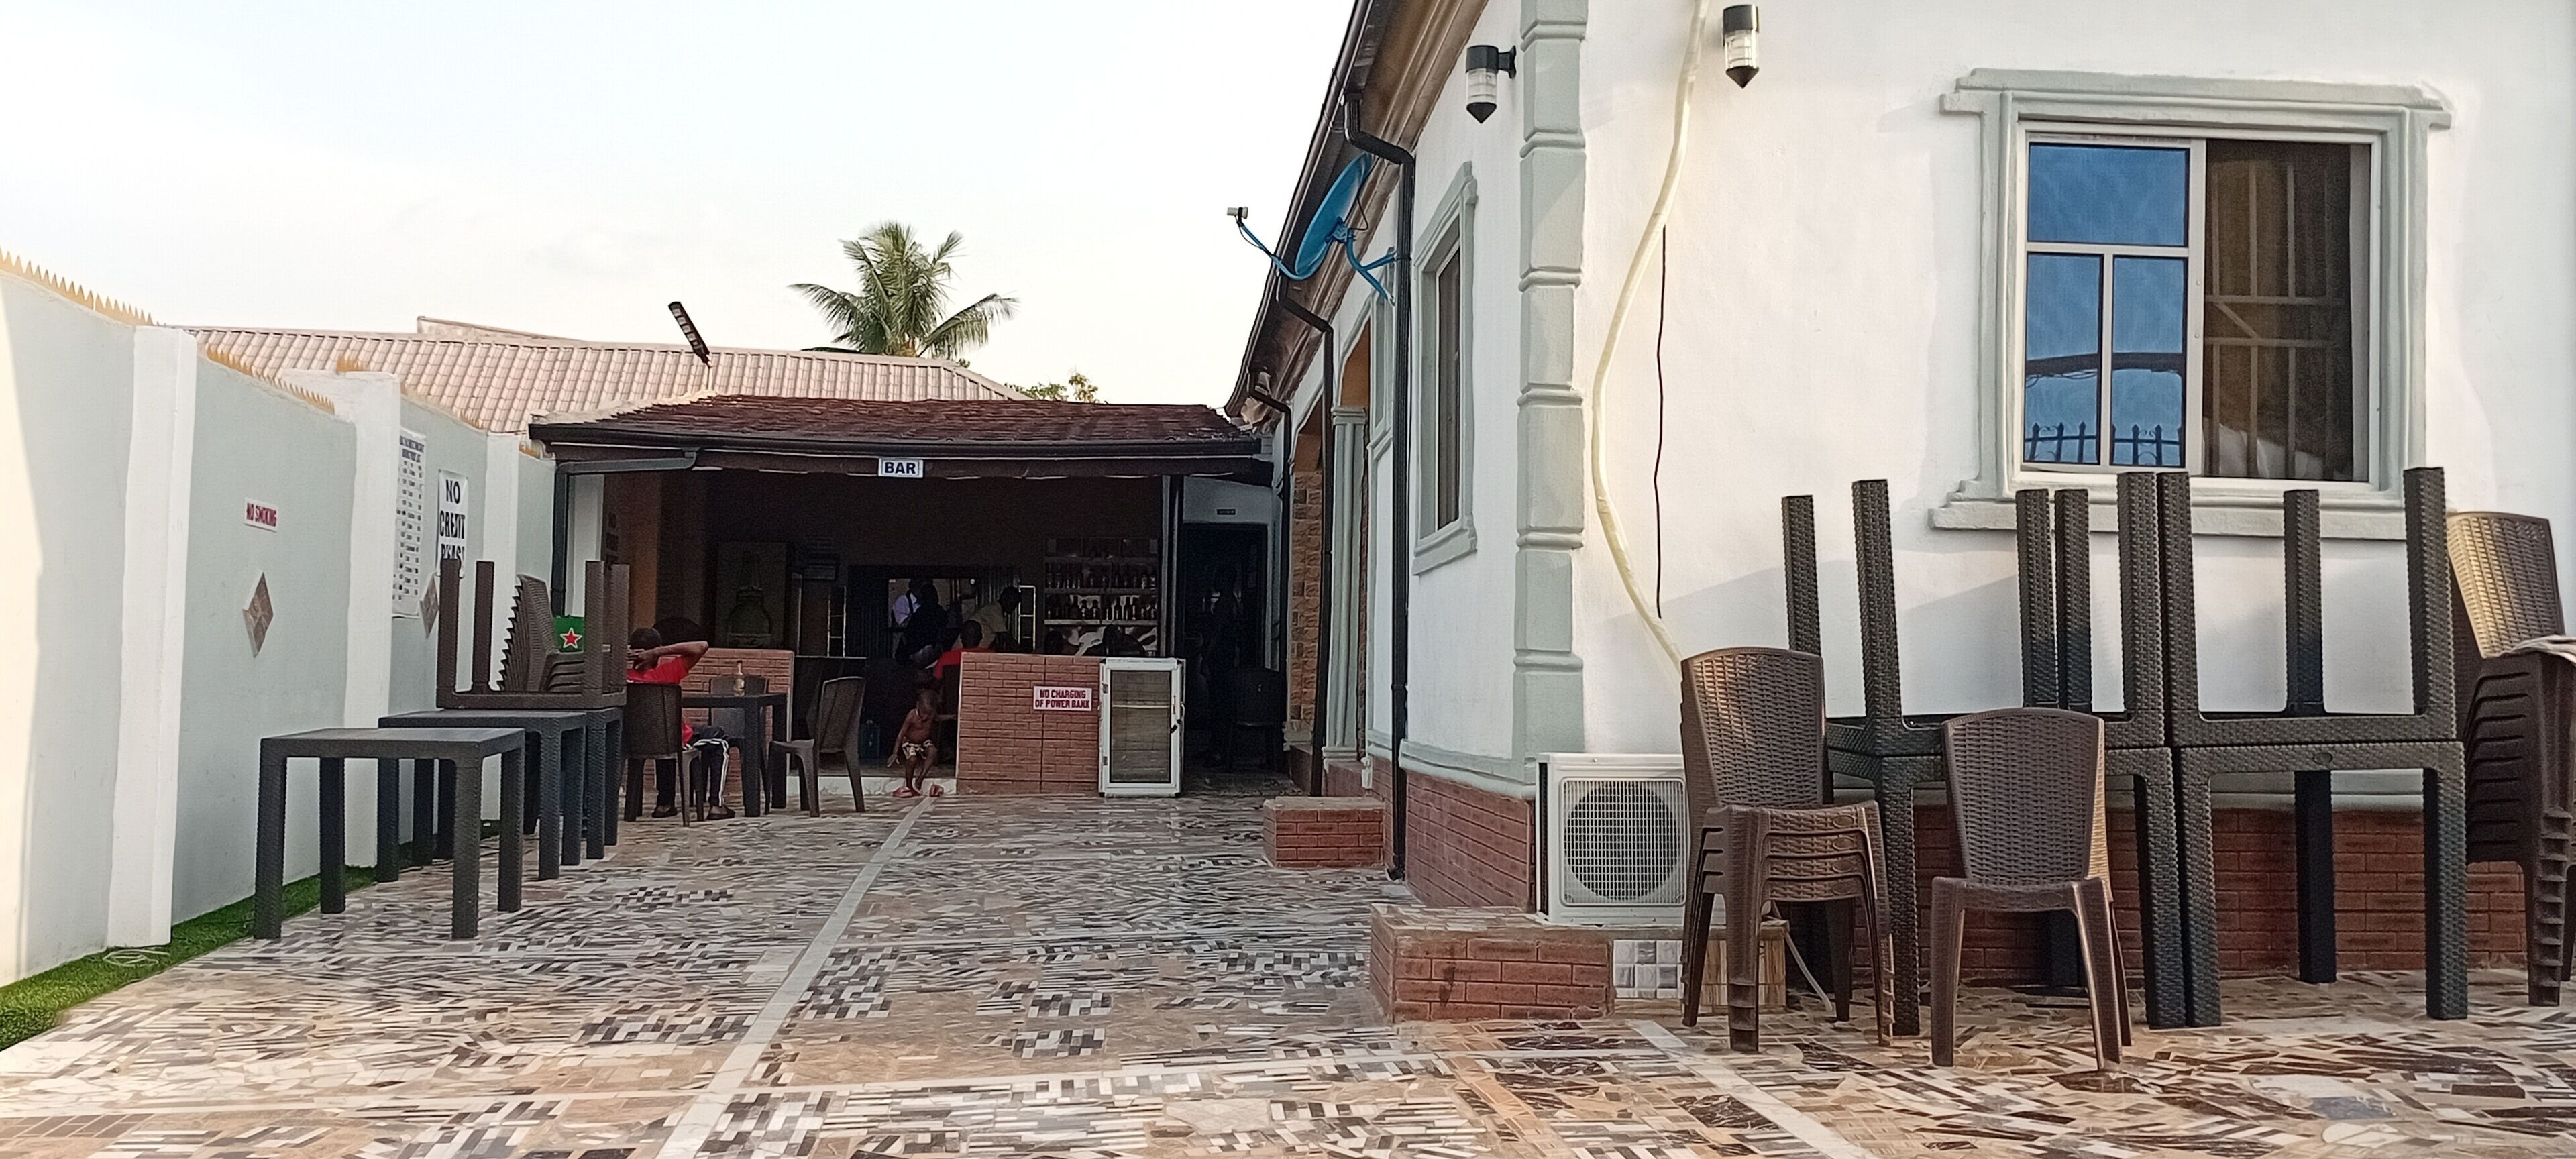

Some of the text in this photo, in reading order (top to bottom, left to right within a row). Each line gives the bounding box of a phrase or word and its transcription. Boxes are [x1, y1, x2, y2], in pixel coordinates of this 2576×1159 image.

[885, 462, 916, 474] BAR
[445, 479, 460, 504] NO
[247, 502, 276, 527] NO SMOKING
[439, 510, 465, 539] CREDIT
[1040, 689, 1086, 699] NO CHARGING
[1035, 700, 1090, 708] OF POWER BANK
